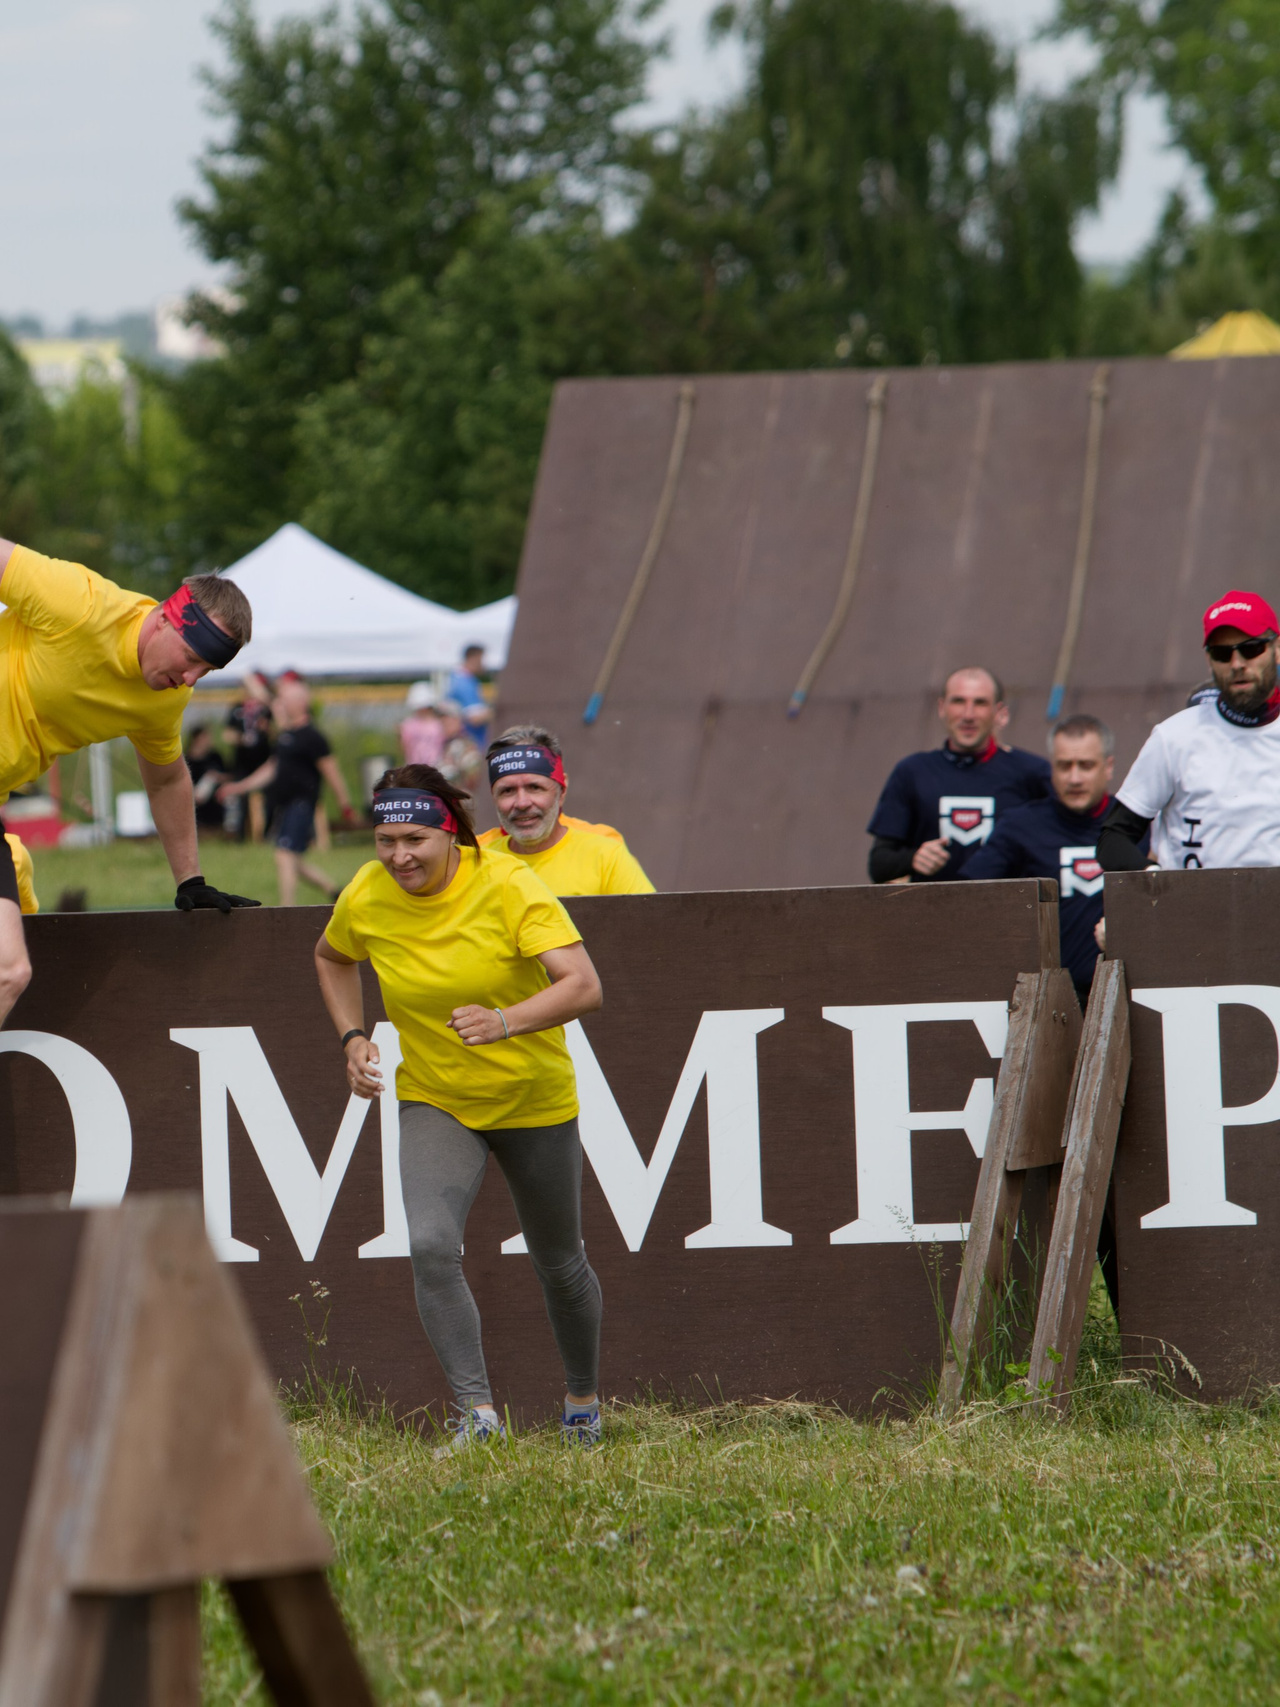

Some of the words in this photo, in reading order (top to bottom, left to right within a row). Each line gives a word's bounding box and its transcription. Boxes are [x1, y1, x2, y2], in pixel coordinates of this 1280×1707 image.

[526, 750, 541, 759] 59
[498, 761, 526, 773] 2806
[374, 801, 411, 812] РОДЕО
[415, 801, 431, 811] 59
[383, 813, 414, 823] 2807
